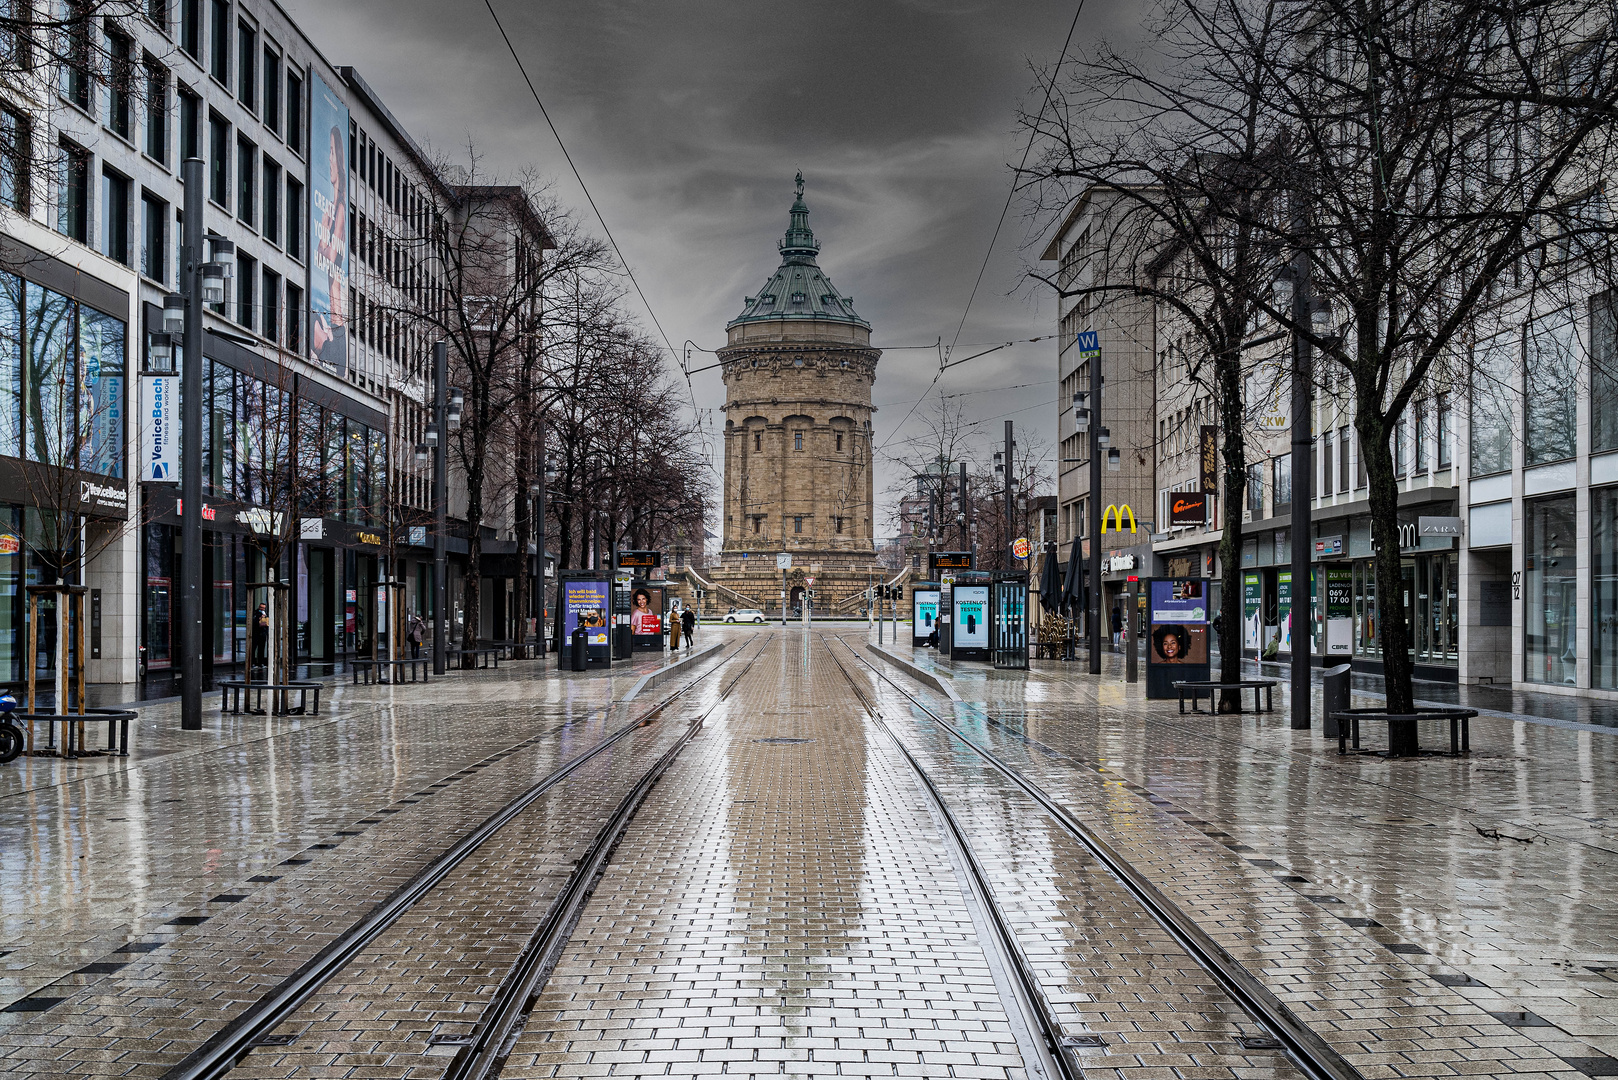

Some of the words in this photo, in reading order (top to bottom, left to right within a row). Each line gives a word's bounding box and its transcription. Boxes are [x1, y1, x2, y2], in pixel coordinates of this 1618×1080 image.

[314, 189, 335, 221] CREATE
[314, 218, 331, 247] YOUR
[332, 233, 346, 258] OWN
[314, 249, 346, 287] HAPPINESS
[1080, 334, 1095, 349] W
[152, 378, 163, 461] VeniceBeach
[1260, 417, 1286, 426] ZKW
[1329, 589, 1342, 597] 069
